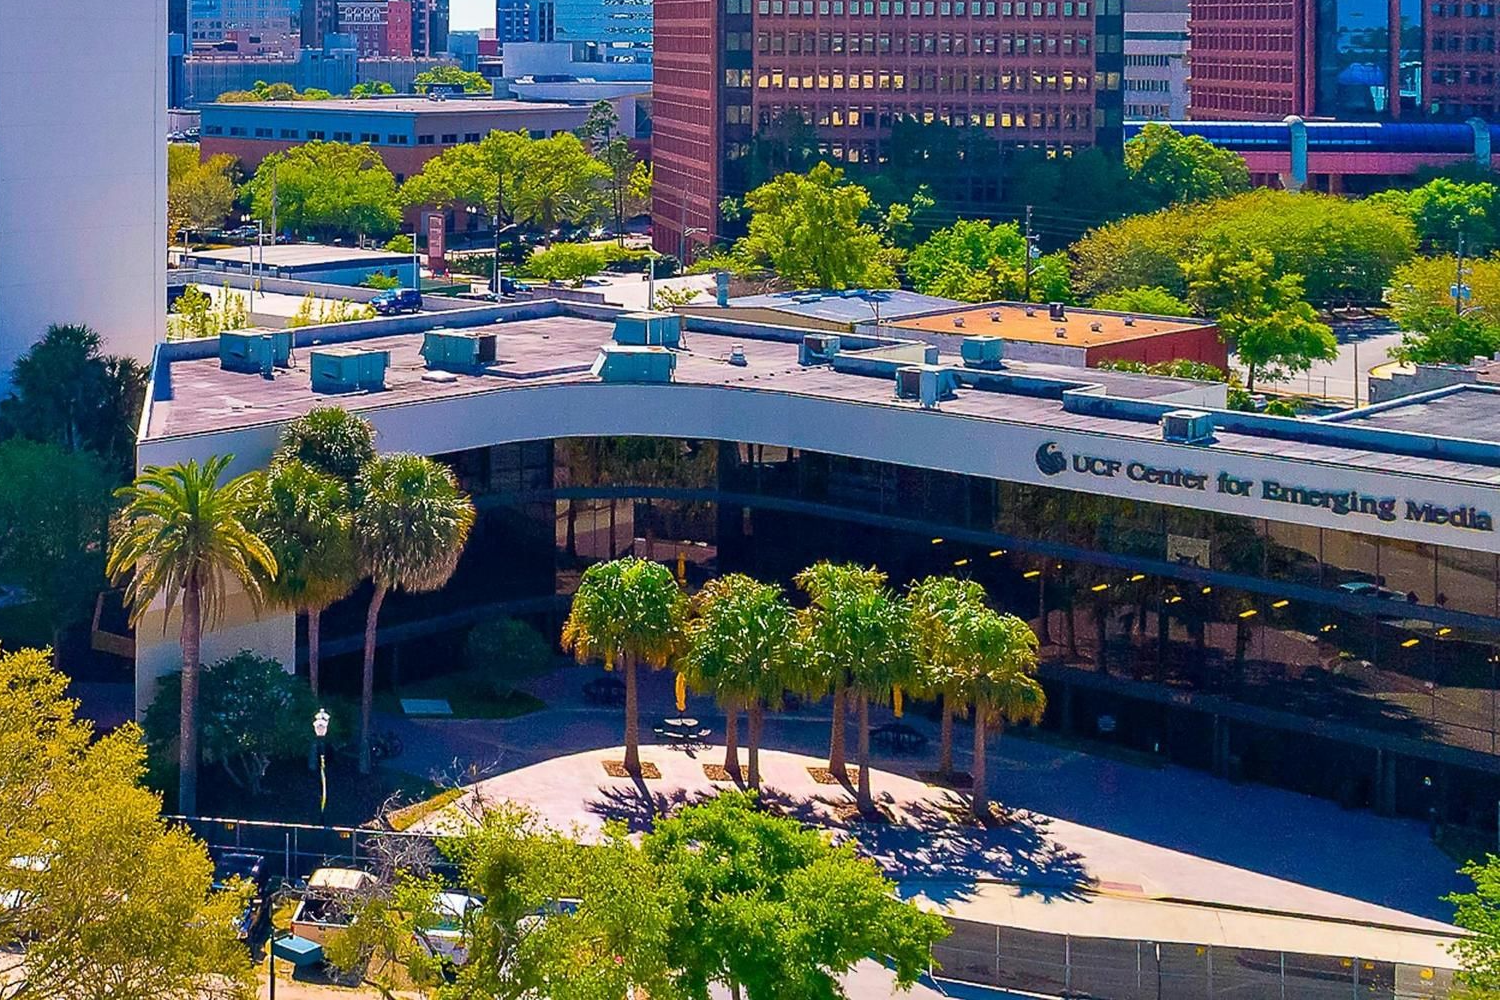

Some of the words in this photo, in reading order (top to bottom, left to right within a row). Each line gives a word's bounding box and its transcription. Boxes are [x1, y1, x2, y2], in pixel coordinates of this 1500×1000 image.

[1072, 453, 1122, 478] UCF
[1126, 462, 1209, 491] Center
[1217, 470, 1254, 497] for
[1261, 479, 1398, 522] Emerging
[1404, 499, 1494, 532] Media
